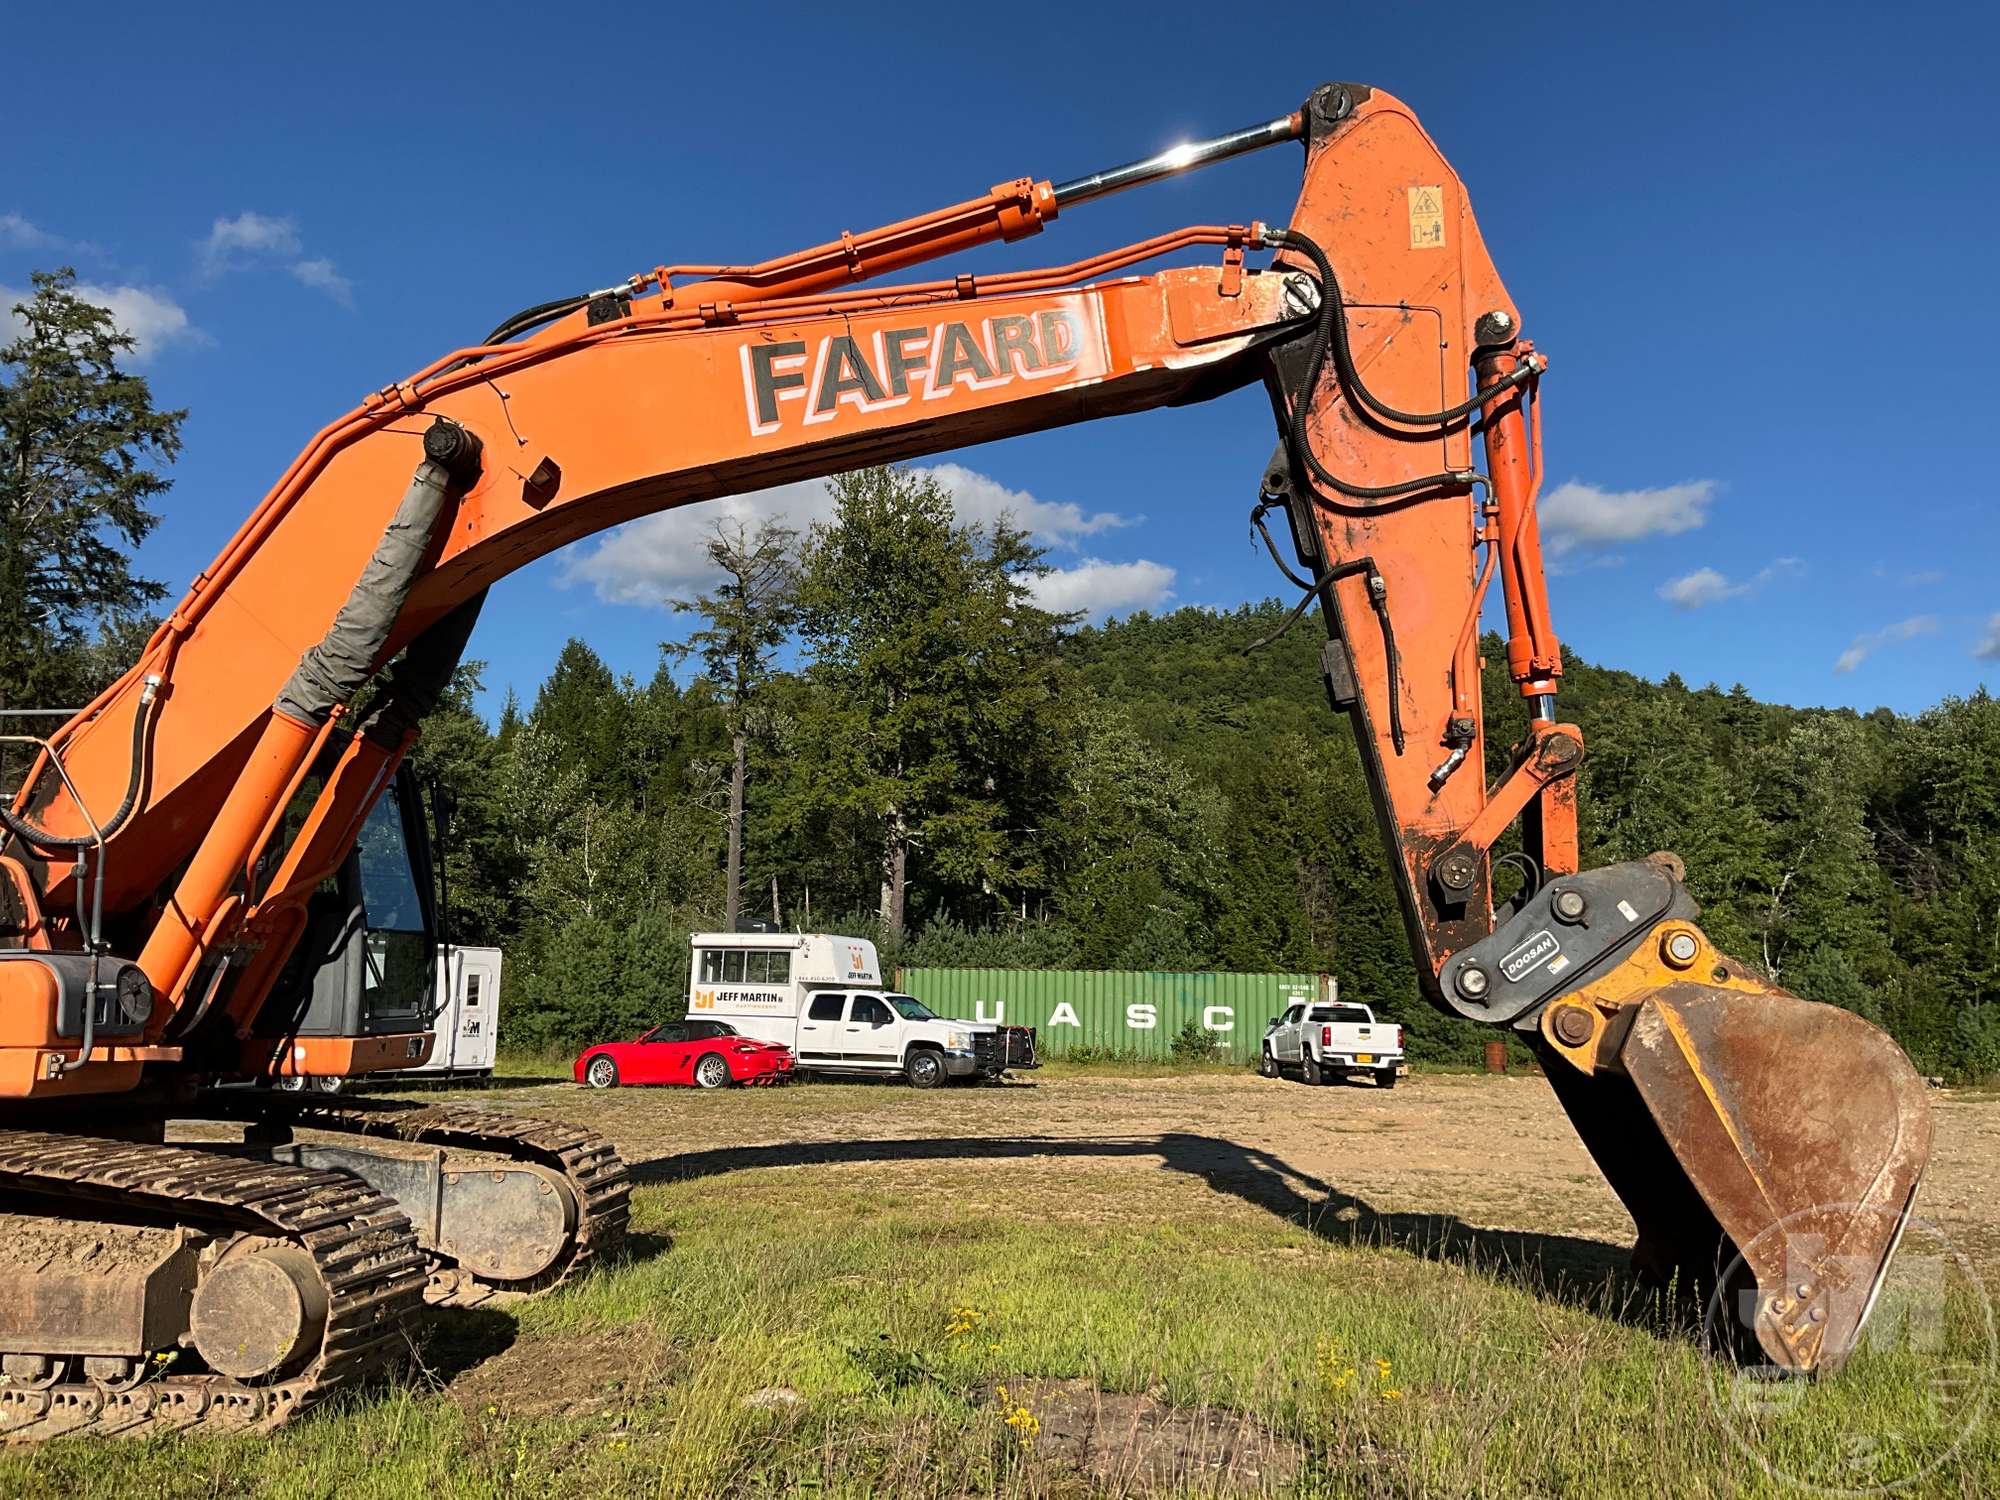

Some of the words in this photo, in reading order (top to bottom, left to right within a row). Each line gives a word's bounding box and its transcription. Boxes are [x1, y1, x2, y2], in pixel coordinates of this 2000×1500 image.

[740, 311, 1085, 435] FAFARD
[1508, 938, 1552, 974] DOOSAN
[716, 991, 739, 1002] JEFF
[740, 992, 777, 1003] MARTIN
